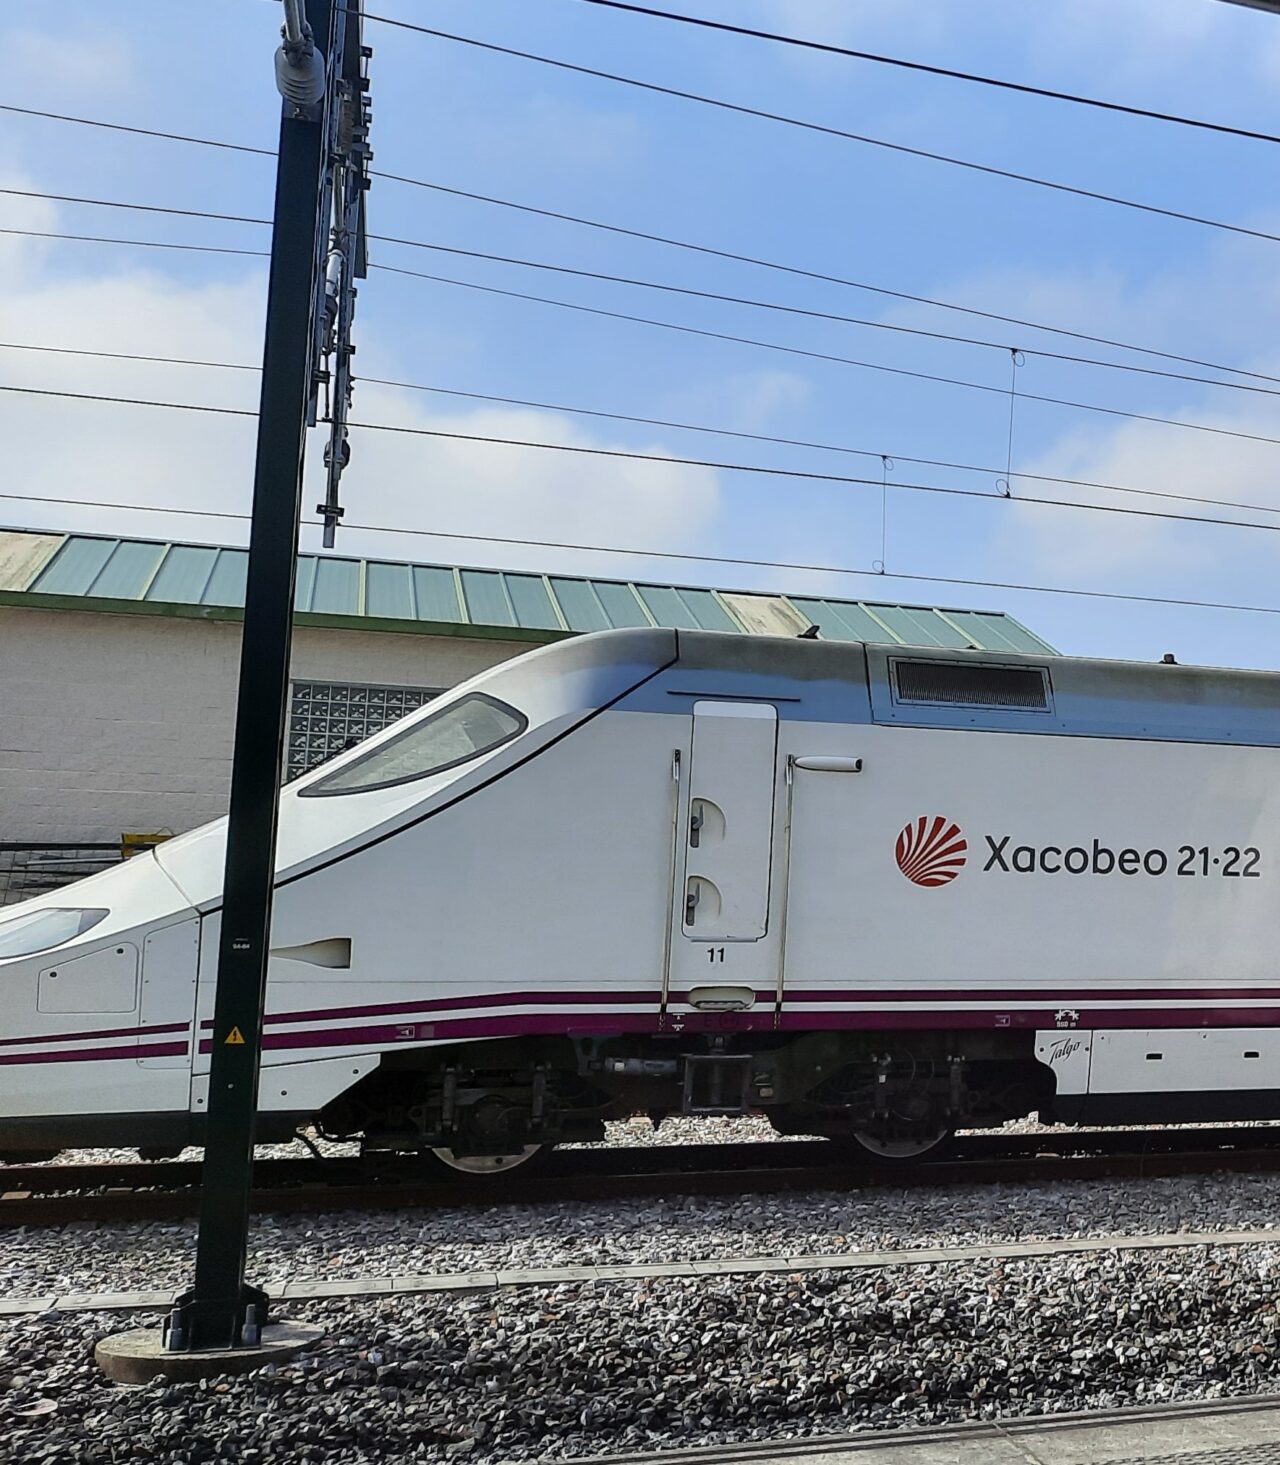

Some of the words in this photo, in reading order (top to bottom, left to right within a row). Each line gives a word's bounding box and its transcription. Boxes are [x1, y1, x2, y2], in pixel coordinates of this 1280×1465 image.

[983, 835, 1168, 876] Xacobeo
[707, 947, 725, 963] 11
[1048, 1037, 1081, 1067] Talgo
